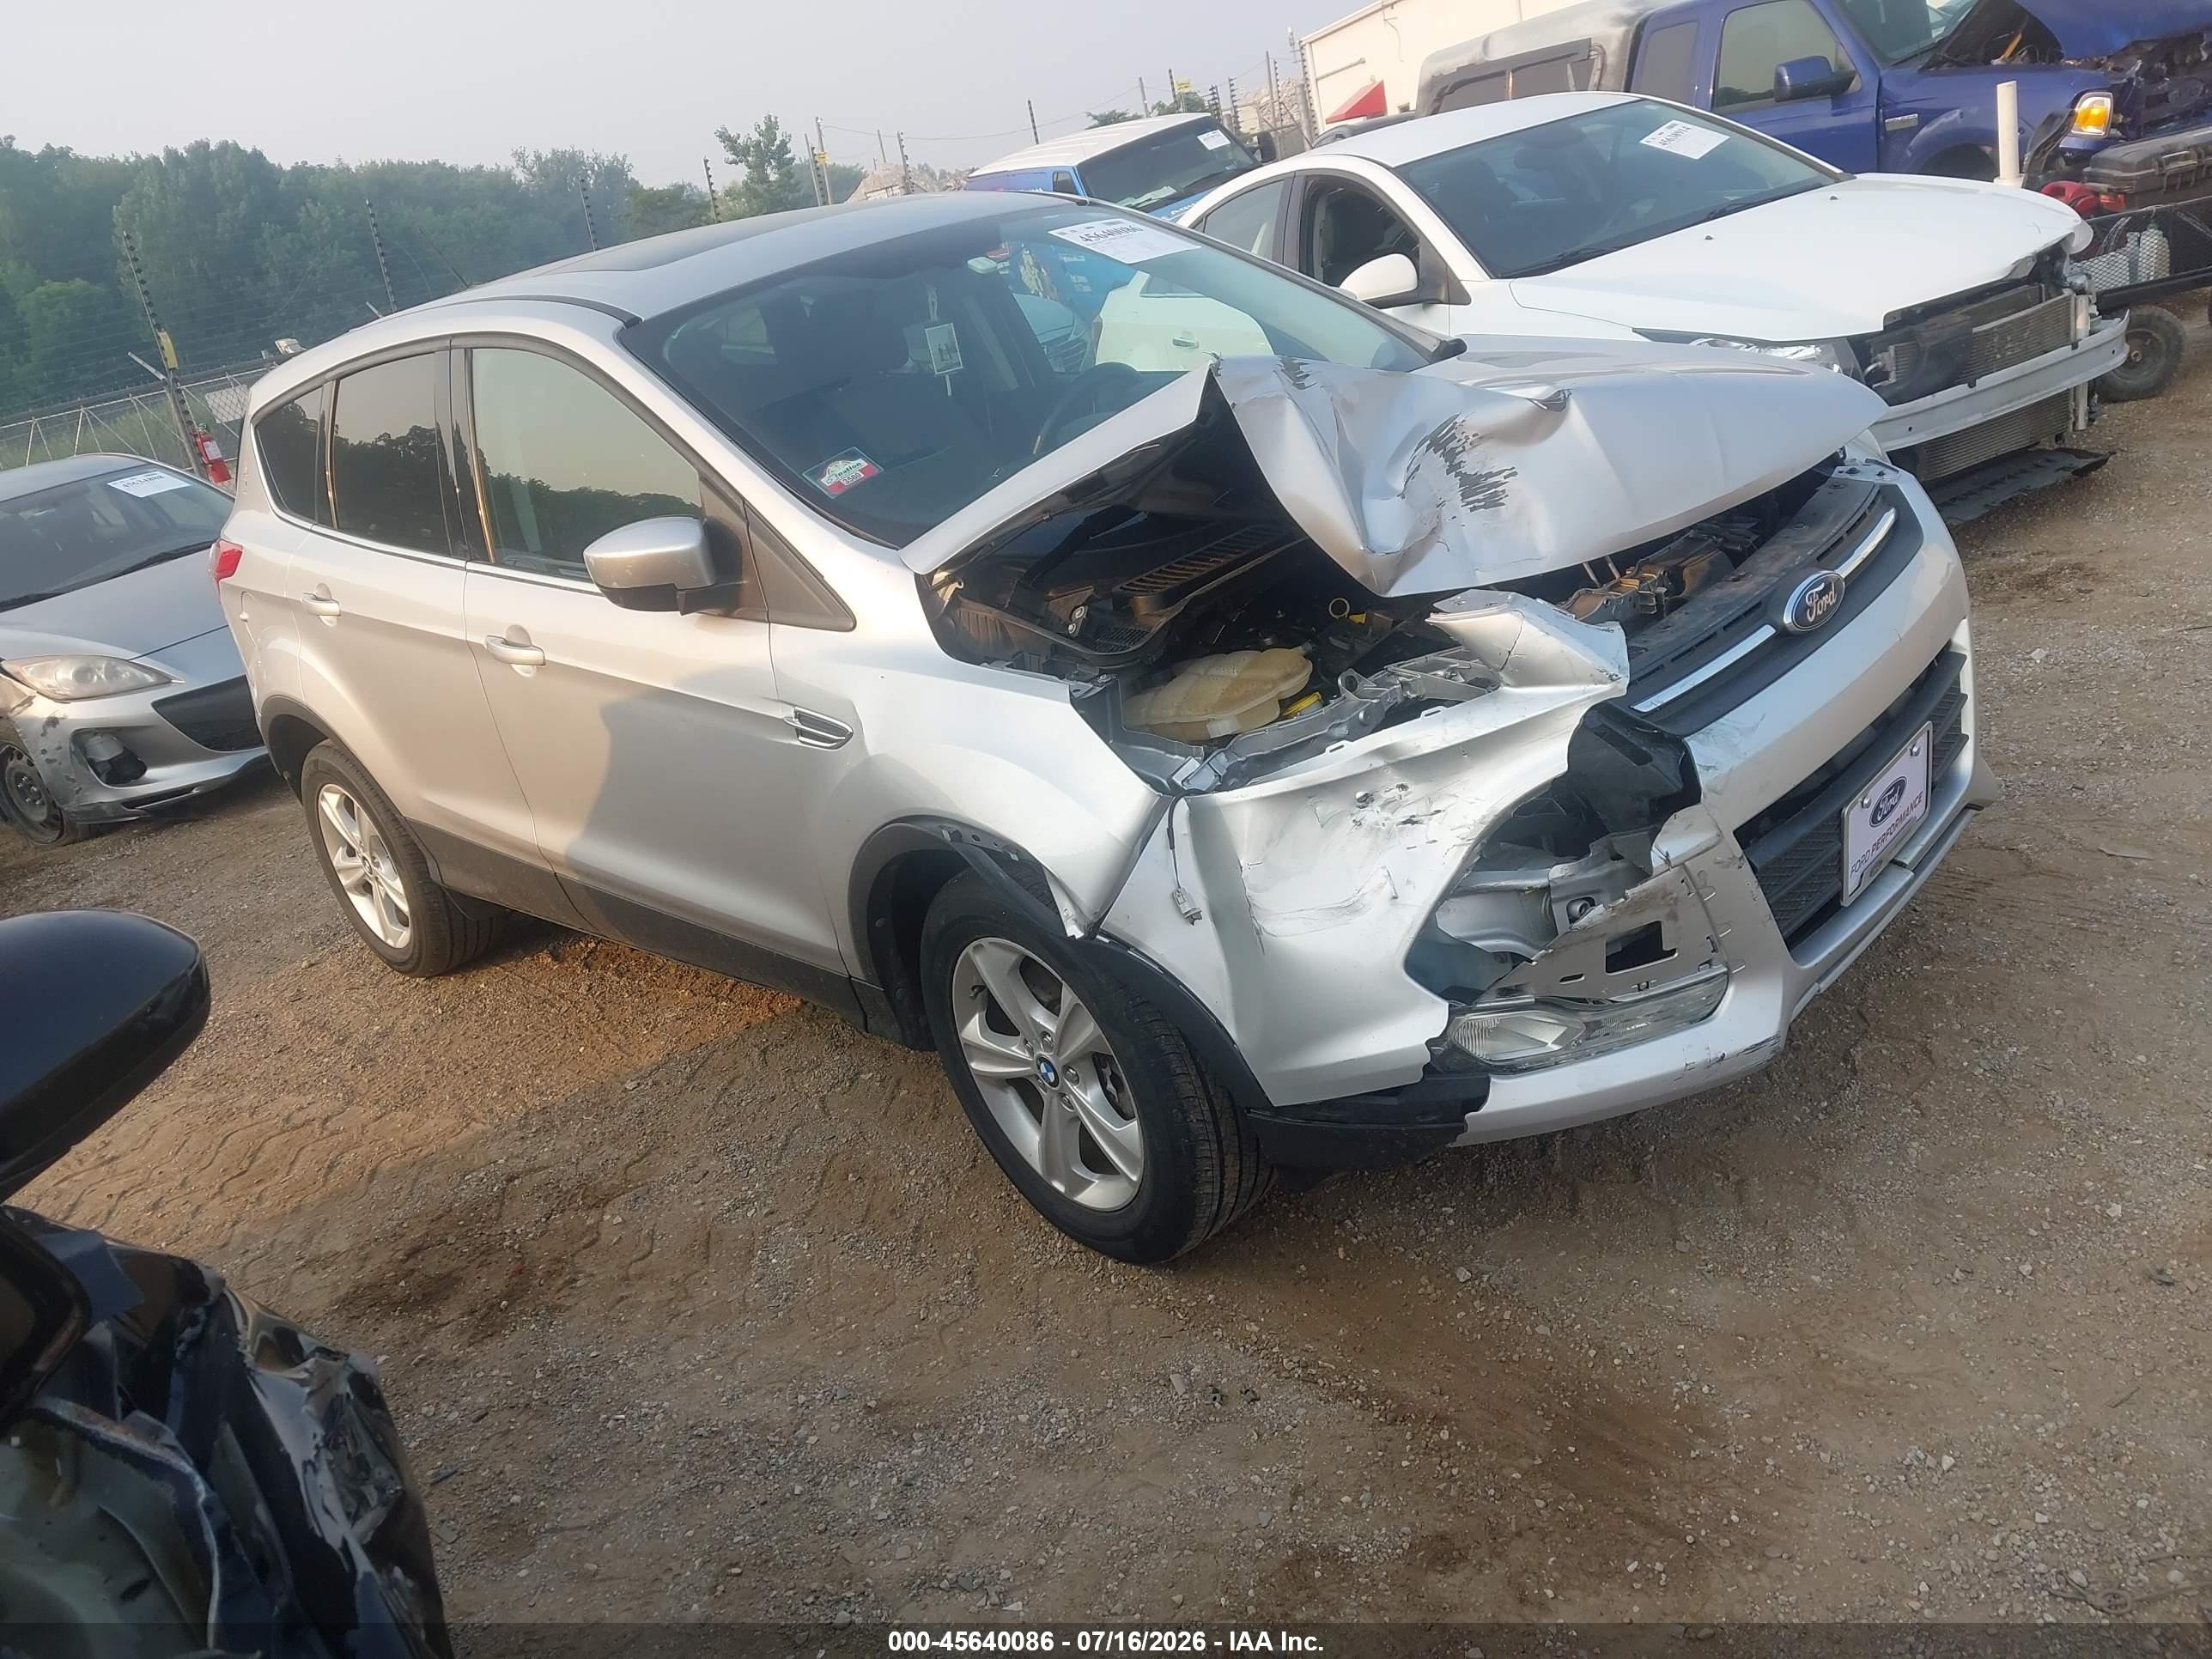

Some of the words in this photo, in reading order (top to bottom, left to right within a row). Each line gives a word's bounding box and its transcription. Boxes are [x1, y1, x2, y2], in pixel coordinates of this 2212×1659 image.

[1805, 581, 1838, 623] Ford
[1877, 785, 1900, 823] Ford
[1850, 848, 1872, 878] FORD
[1870, 790, 1923, 857] PERFORMANCE
